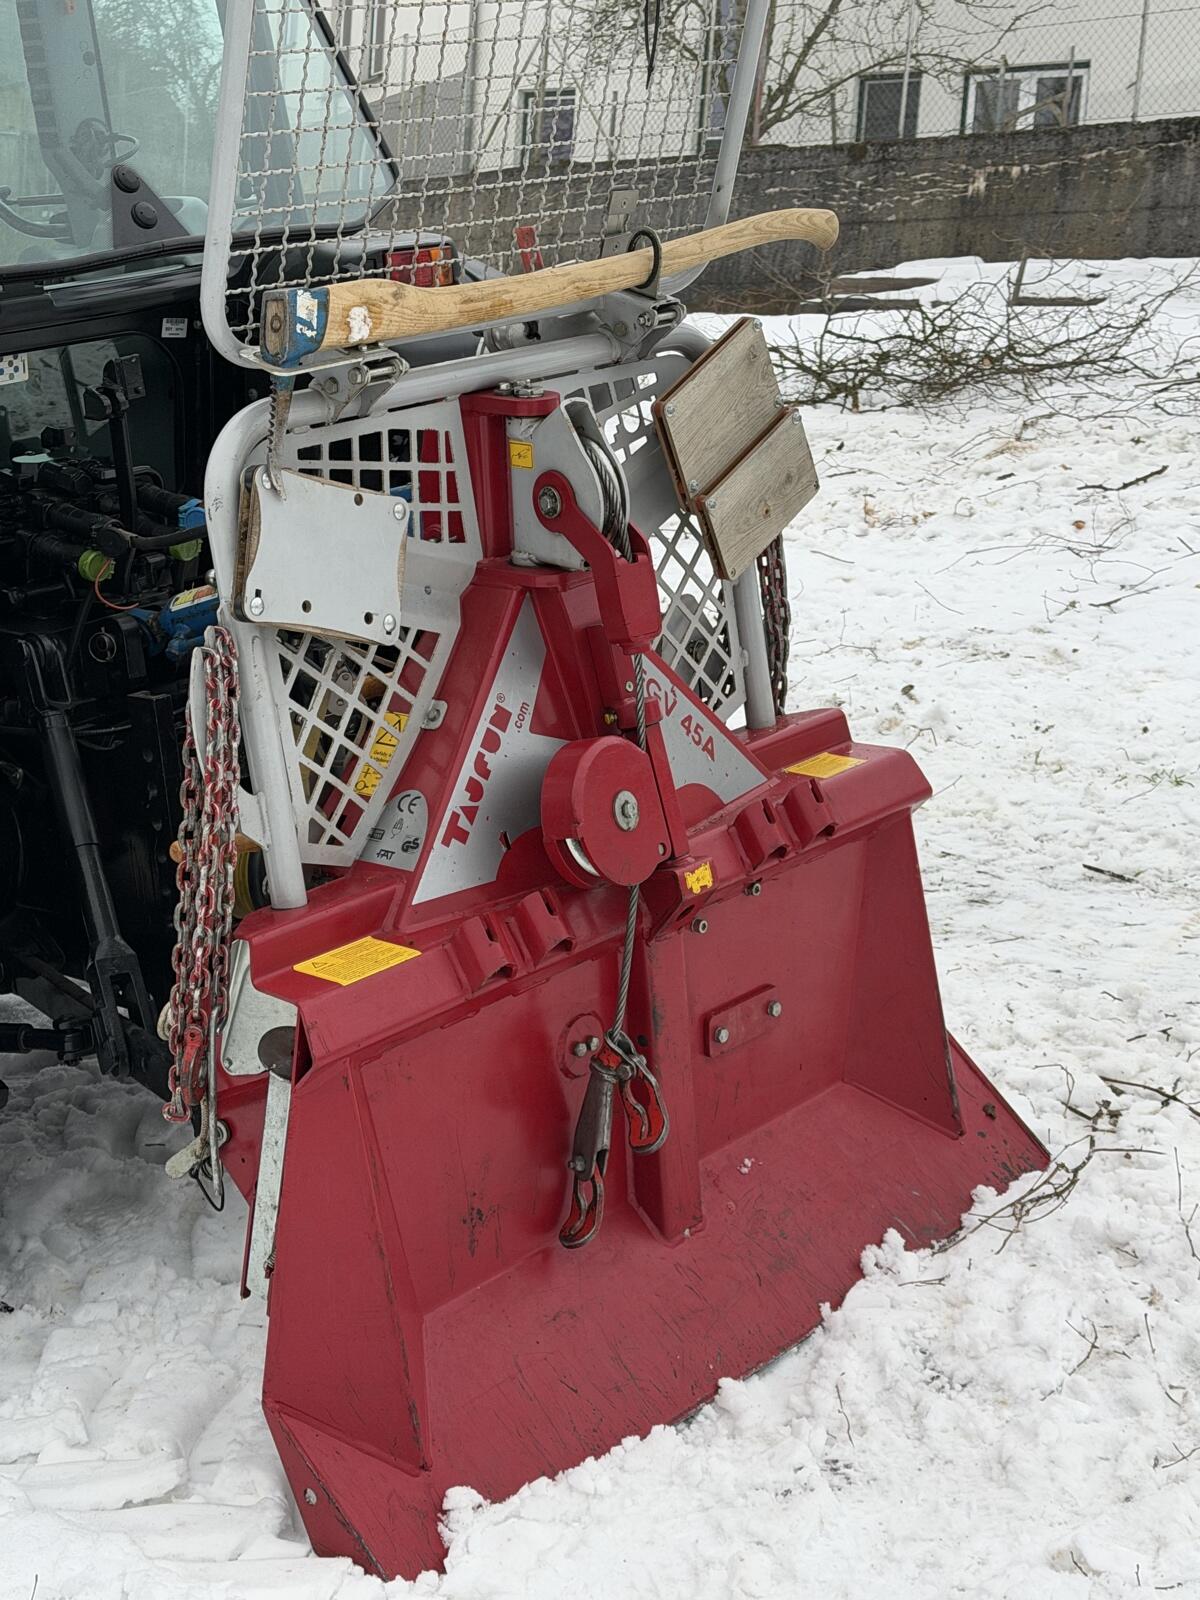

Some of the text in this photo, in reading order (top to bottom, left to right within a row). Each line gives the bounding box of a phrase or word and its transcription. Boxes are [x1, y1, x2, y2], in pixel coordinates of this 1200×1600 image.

[514, 701, 530, 734] .com
[680, 714, 716, 763] 45A
[397, 793, 423, 815] CE
